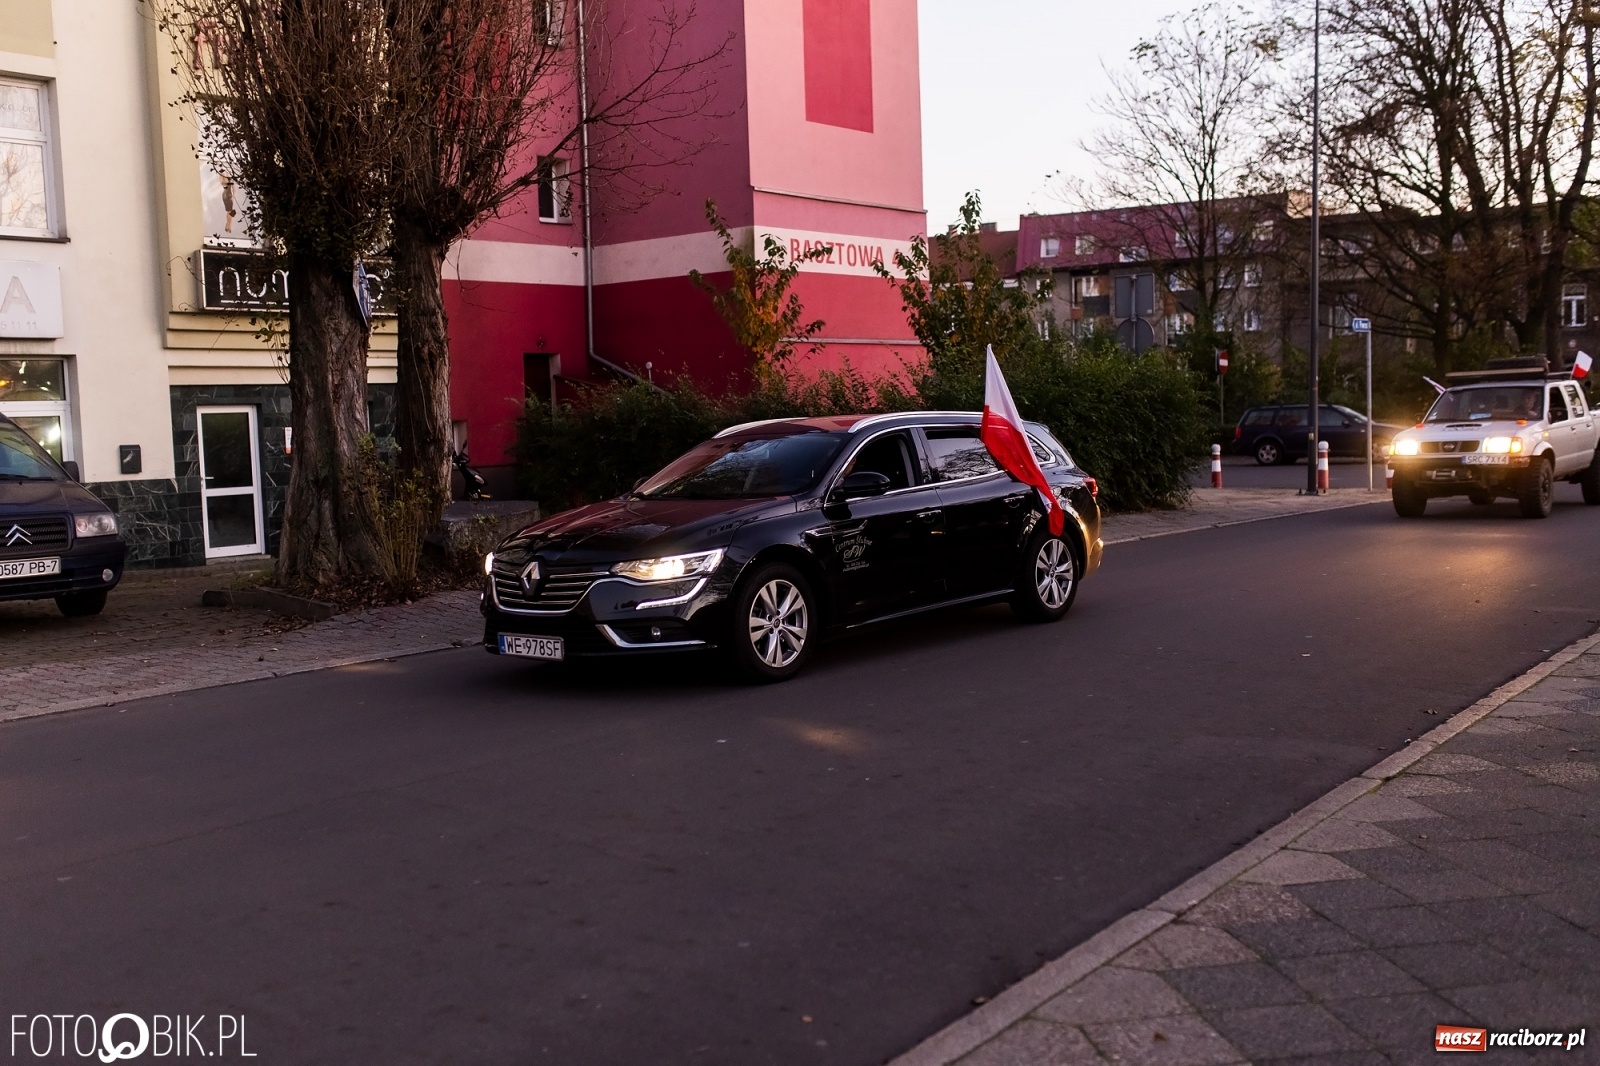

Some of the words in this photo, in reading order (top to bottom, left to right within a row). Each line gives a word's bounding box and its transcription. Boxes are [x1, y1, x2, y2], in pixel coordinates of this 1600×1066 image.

[790, 238, 884, 267] BASZTOWA
[29, 560, 57, 574] PB-7
[525, 639, 560, 657] 978SF
